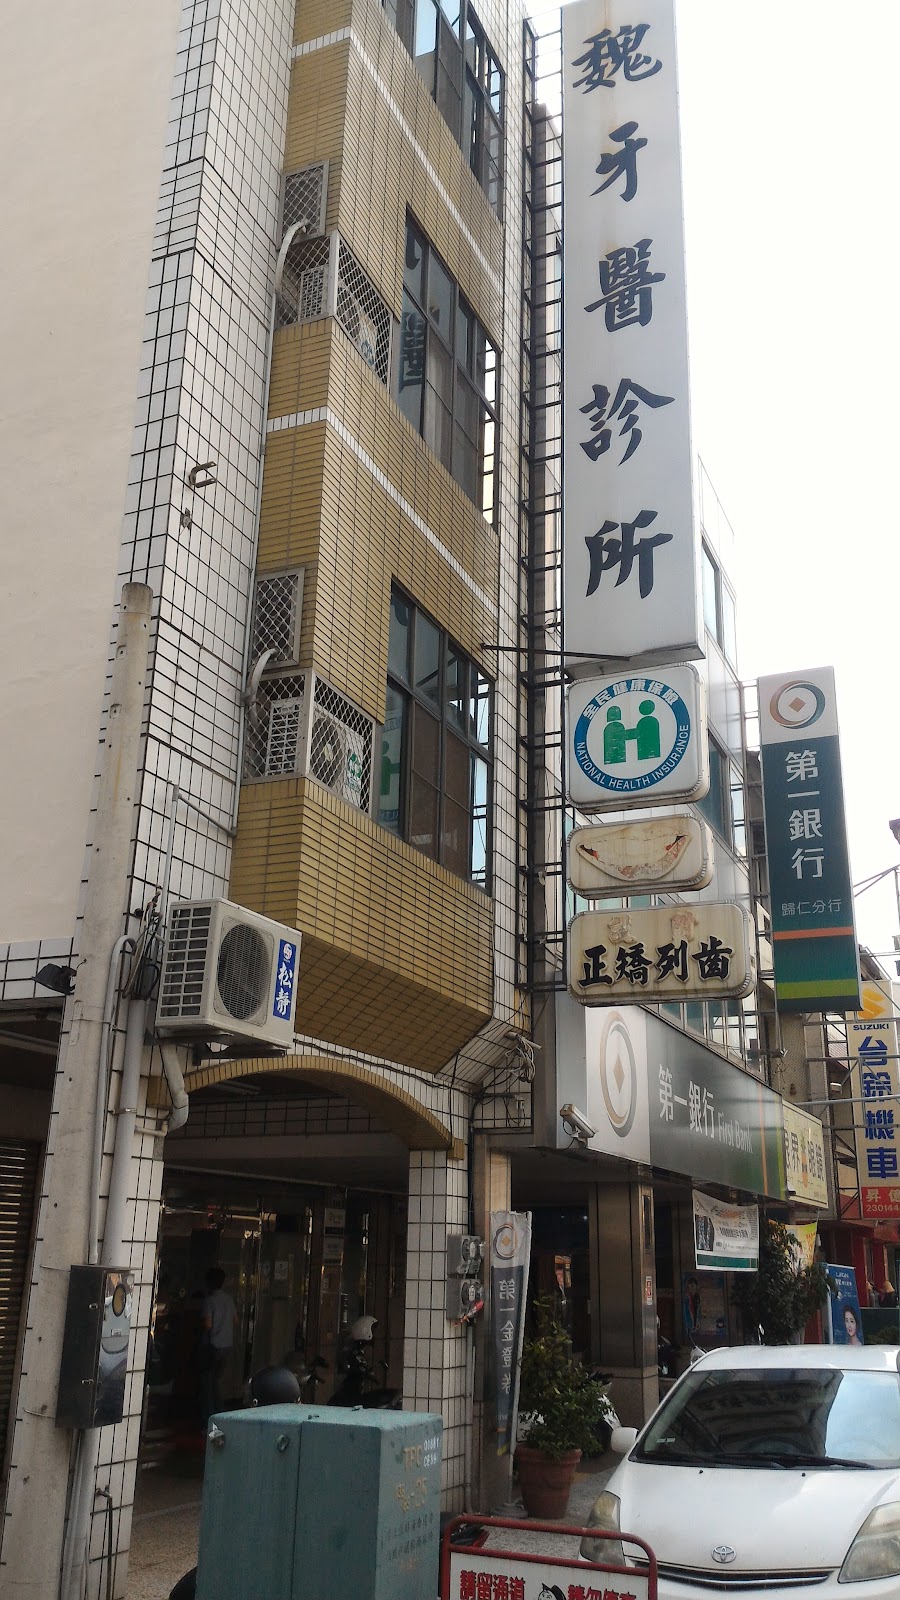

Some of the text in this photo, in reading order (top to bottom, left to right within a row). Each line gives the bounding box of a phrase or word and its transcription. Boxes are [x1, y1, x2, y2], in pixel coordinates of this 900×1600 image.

[571, 22, 675, 600] 魏牙醫診所
[583, 679, 680, 721] 全民健康保險
[576, 724, 689, 790] NATIONAL HEALTH INSURANCE
[785, 749, 825, 880] 第一銀行
[781, 899, 842, 917] 歸仁分行
[853, 1022, 889, 1031] SUZUKI
[658, 1063, 715, 1138] 第一銀行
[717, 1111, 753, 1154] First Bank
[857, 1035, 899, 1179] 台鈴機車
